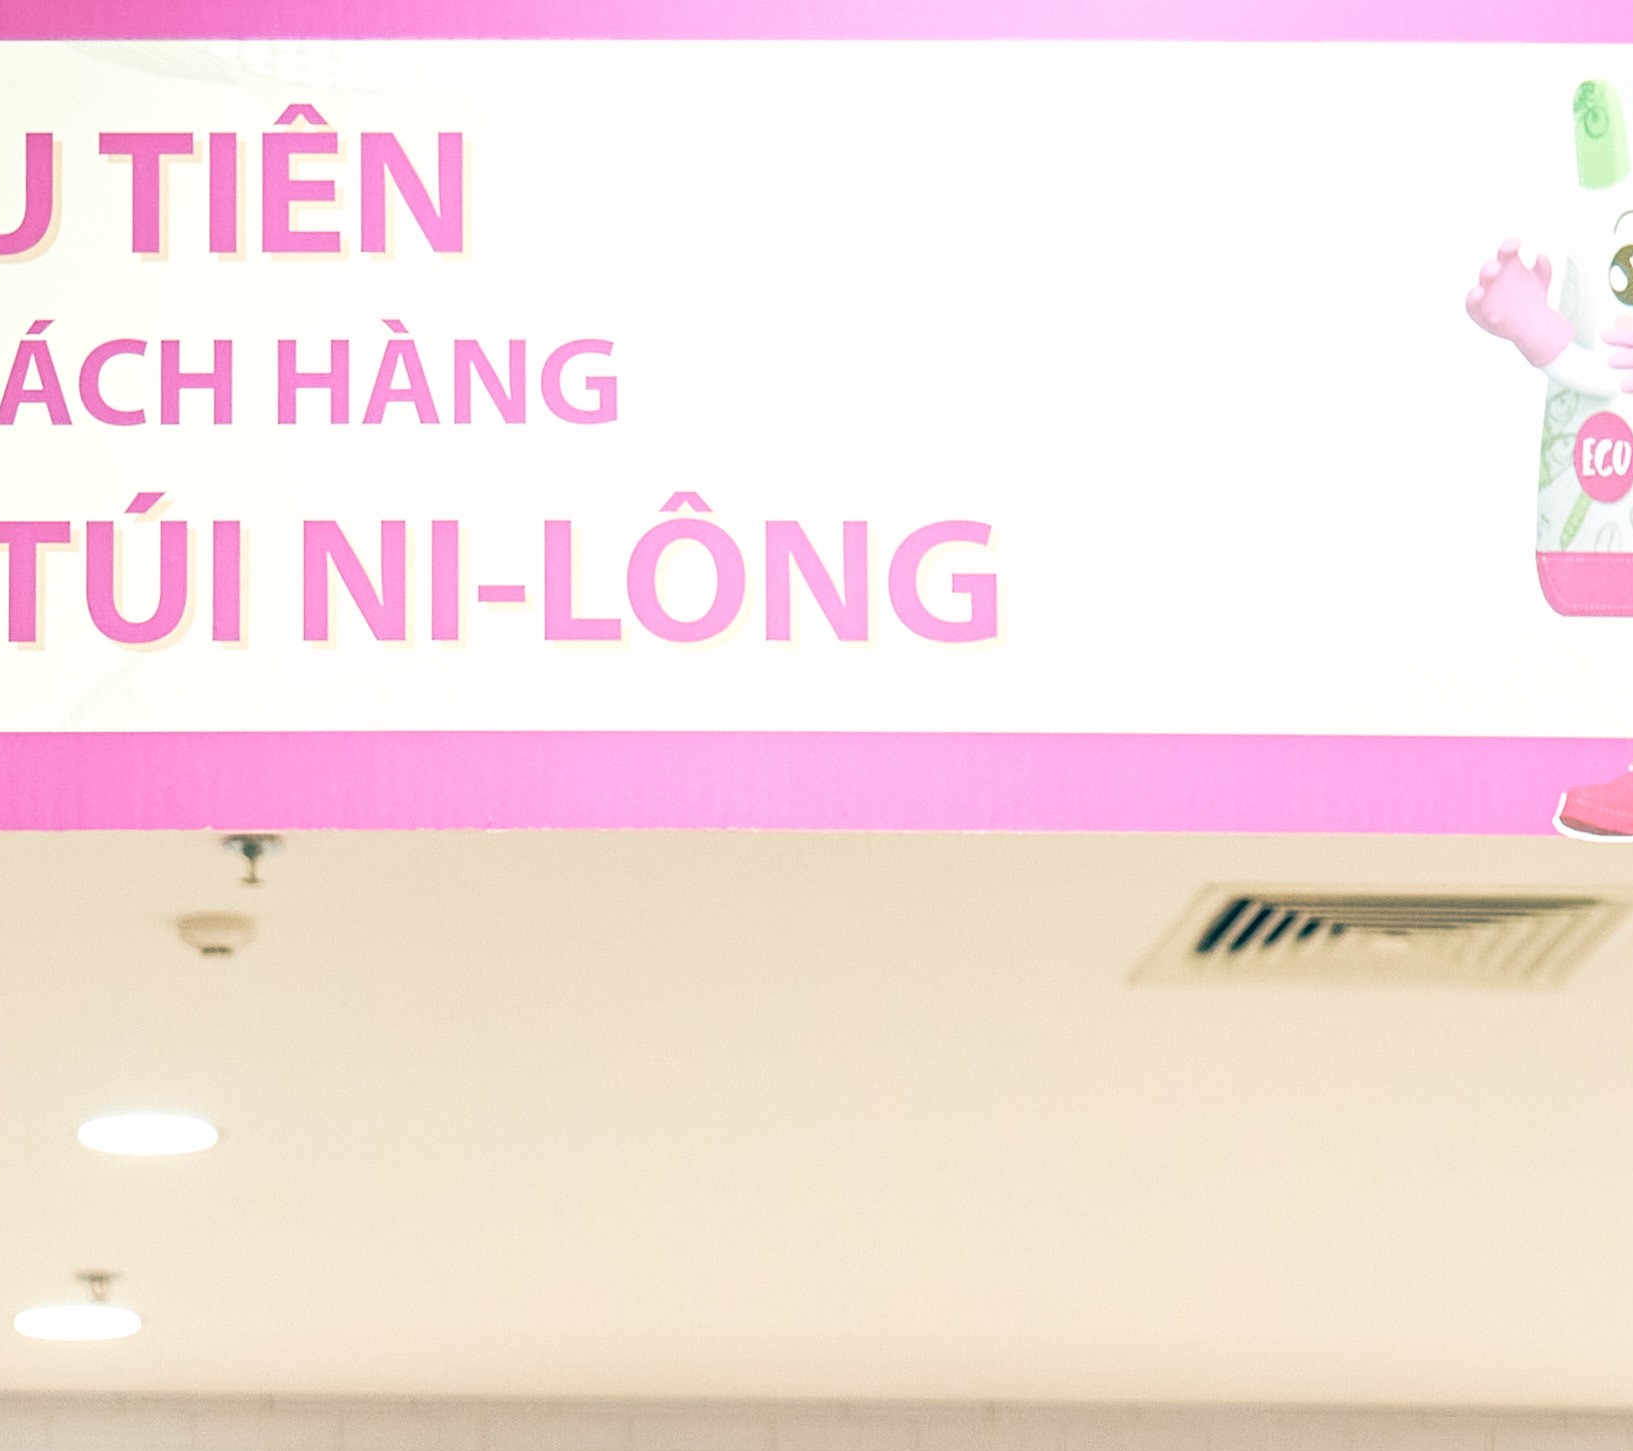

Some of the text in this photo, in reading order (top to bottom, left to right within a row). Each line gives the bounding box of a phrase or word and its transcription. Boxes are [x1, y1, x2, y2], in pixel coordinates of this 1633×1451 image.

[97, 103, 466, 258] TIÊN
[276, 319, 621, 428] HÀNG
[1581, 437, 1633, 478] ECO
[302, 491, 1000, 647] NI-LÔNG
